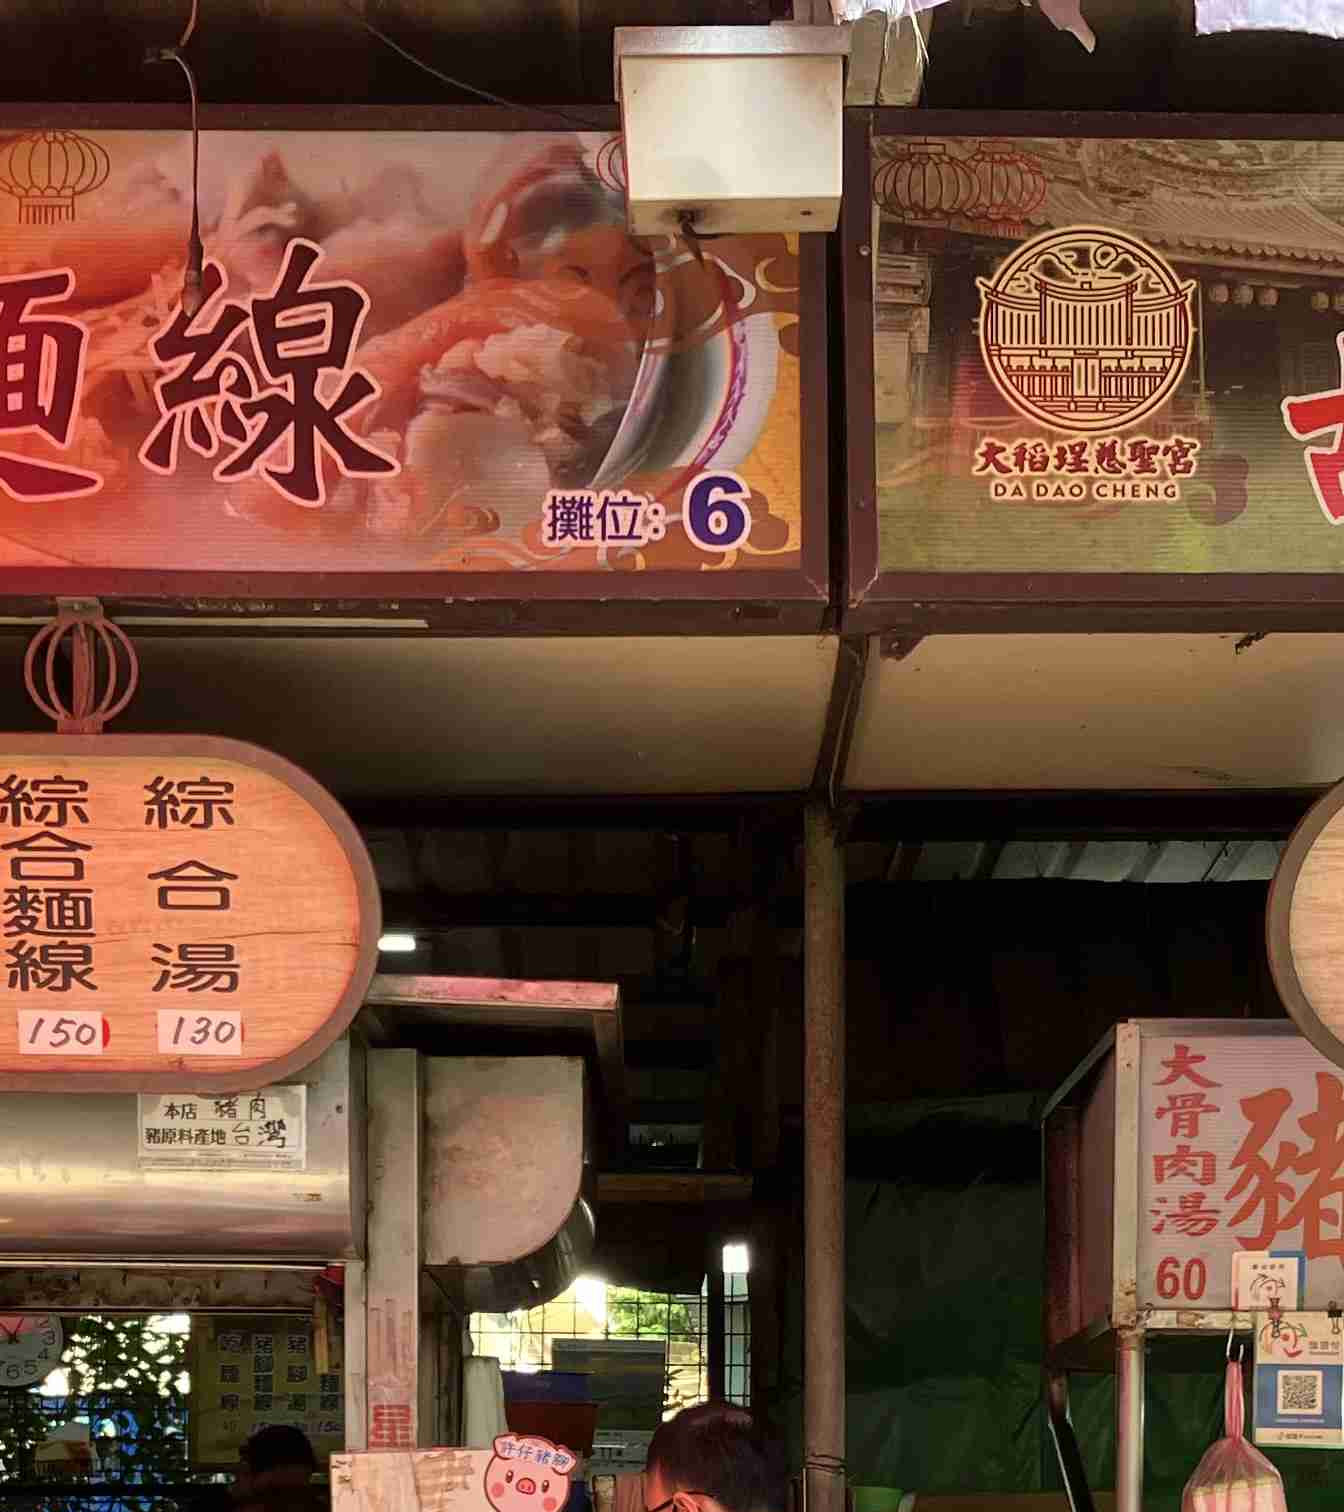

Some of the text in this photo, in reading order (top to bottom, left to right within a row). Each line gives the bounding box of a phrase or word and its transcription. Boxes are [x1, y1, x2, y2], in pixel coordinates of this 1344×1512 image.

[975, 439, 1198, 477] 大稻埕慈聖宮
[688, 475, 745, 545] 6
[993, 483, 1178, 499] DA DAO CHENG
[143, 775, 241, 993] 綜合湯
[28, 1016, 97, 1047] 150
[168, 1016, 236, 1046] 130
[1149, 1044, 1223, 1237] 大骨肉湯
[1156, 1256, 1207, 1300] 60
